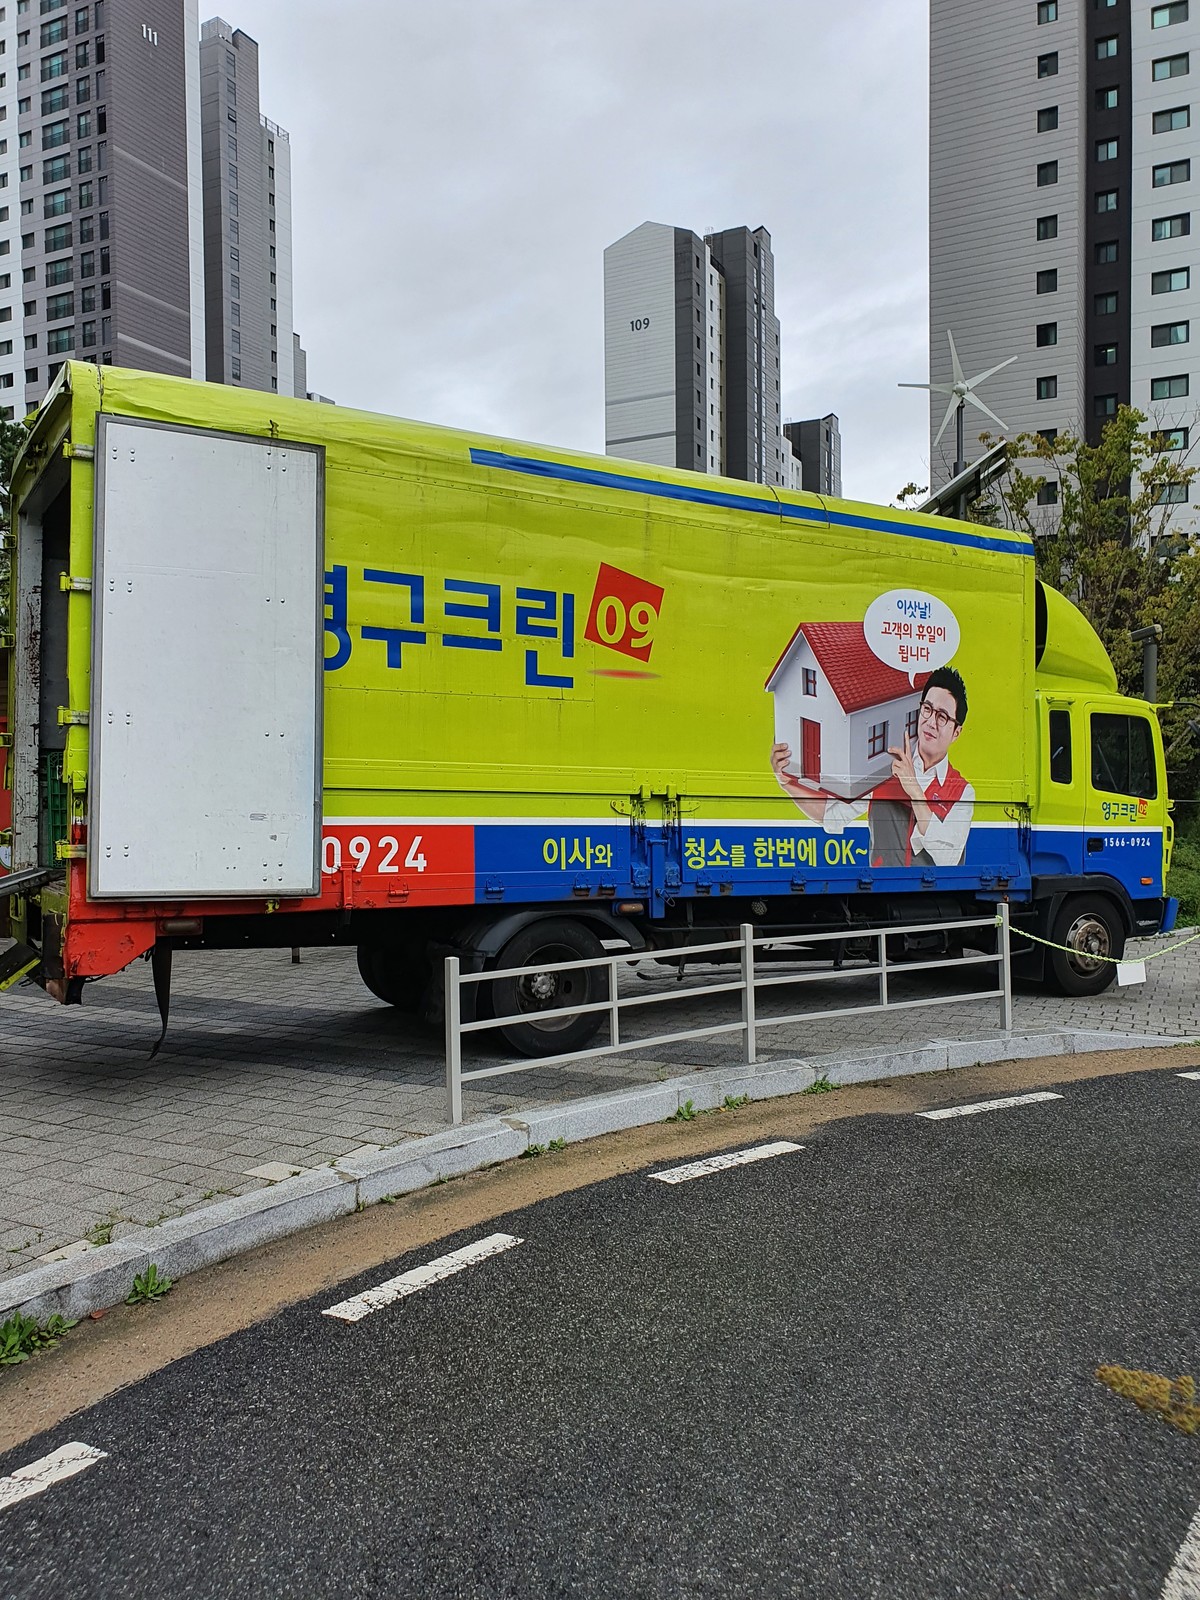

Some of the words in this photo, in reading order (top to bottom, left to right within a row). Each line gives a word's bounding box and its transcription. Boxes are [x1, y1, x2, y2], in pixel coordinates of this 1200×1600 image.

[141, 23, 158, 46] 111
[630, 317, 650, 332] 109
[896, 600, 931, 619] 이삿날!
[596, 595, 660, 649] 09
[881, 621, 912, 640] 고객의
[916, 624, 946, 643] 휴일이
[898, 645, 930, 663] 됩니다
[1102, 801, 1137, 822] 영구크린
[1104, 837, 1151, 847] 1566-0924
[321, 835, 428, 875] 0924
[543, 837, 613, 870] 이사와
[684, 837, 746, 869] 청소를
[753, 837, 817, 867] 한번에
[824, 839, 868, 865] OK~
